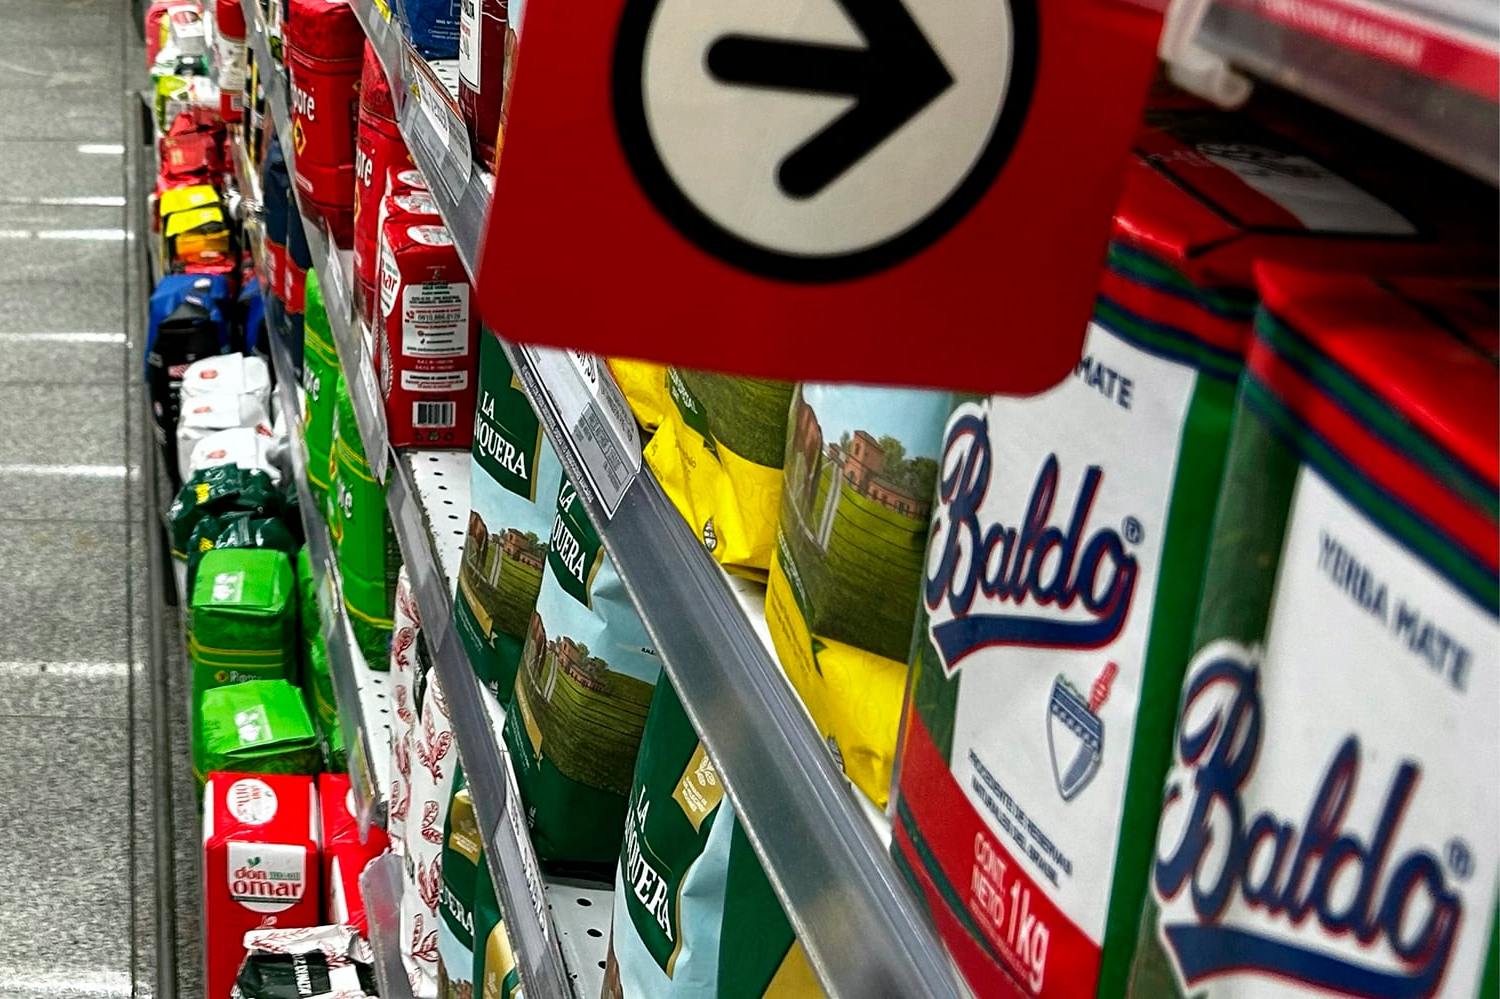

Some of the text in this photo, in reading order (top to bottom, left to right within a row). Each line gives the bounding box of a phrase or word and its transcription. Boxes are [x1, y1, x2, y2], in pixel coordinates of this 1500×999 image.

[481, 391, 495, 421] LA
[558, 480, 577, 513] LA
[927, 414, 1138, 655] Baldo
[1316, 530, 1473, 694] YERBA MATE
[636, 784, 649, 832] LA
[1155, 659, 1462, 985] Baldo
[233, 878, 301, 898] omar
[235, 860, 267, 881] don
